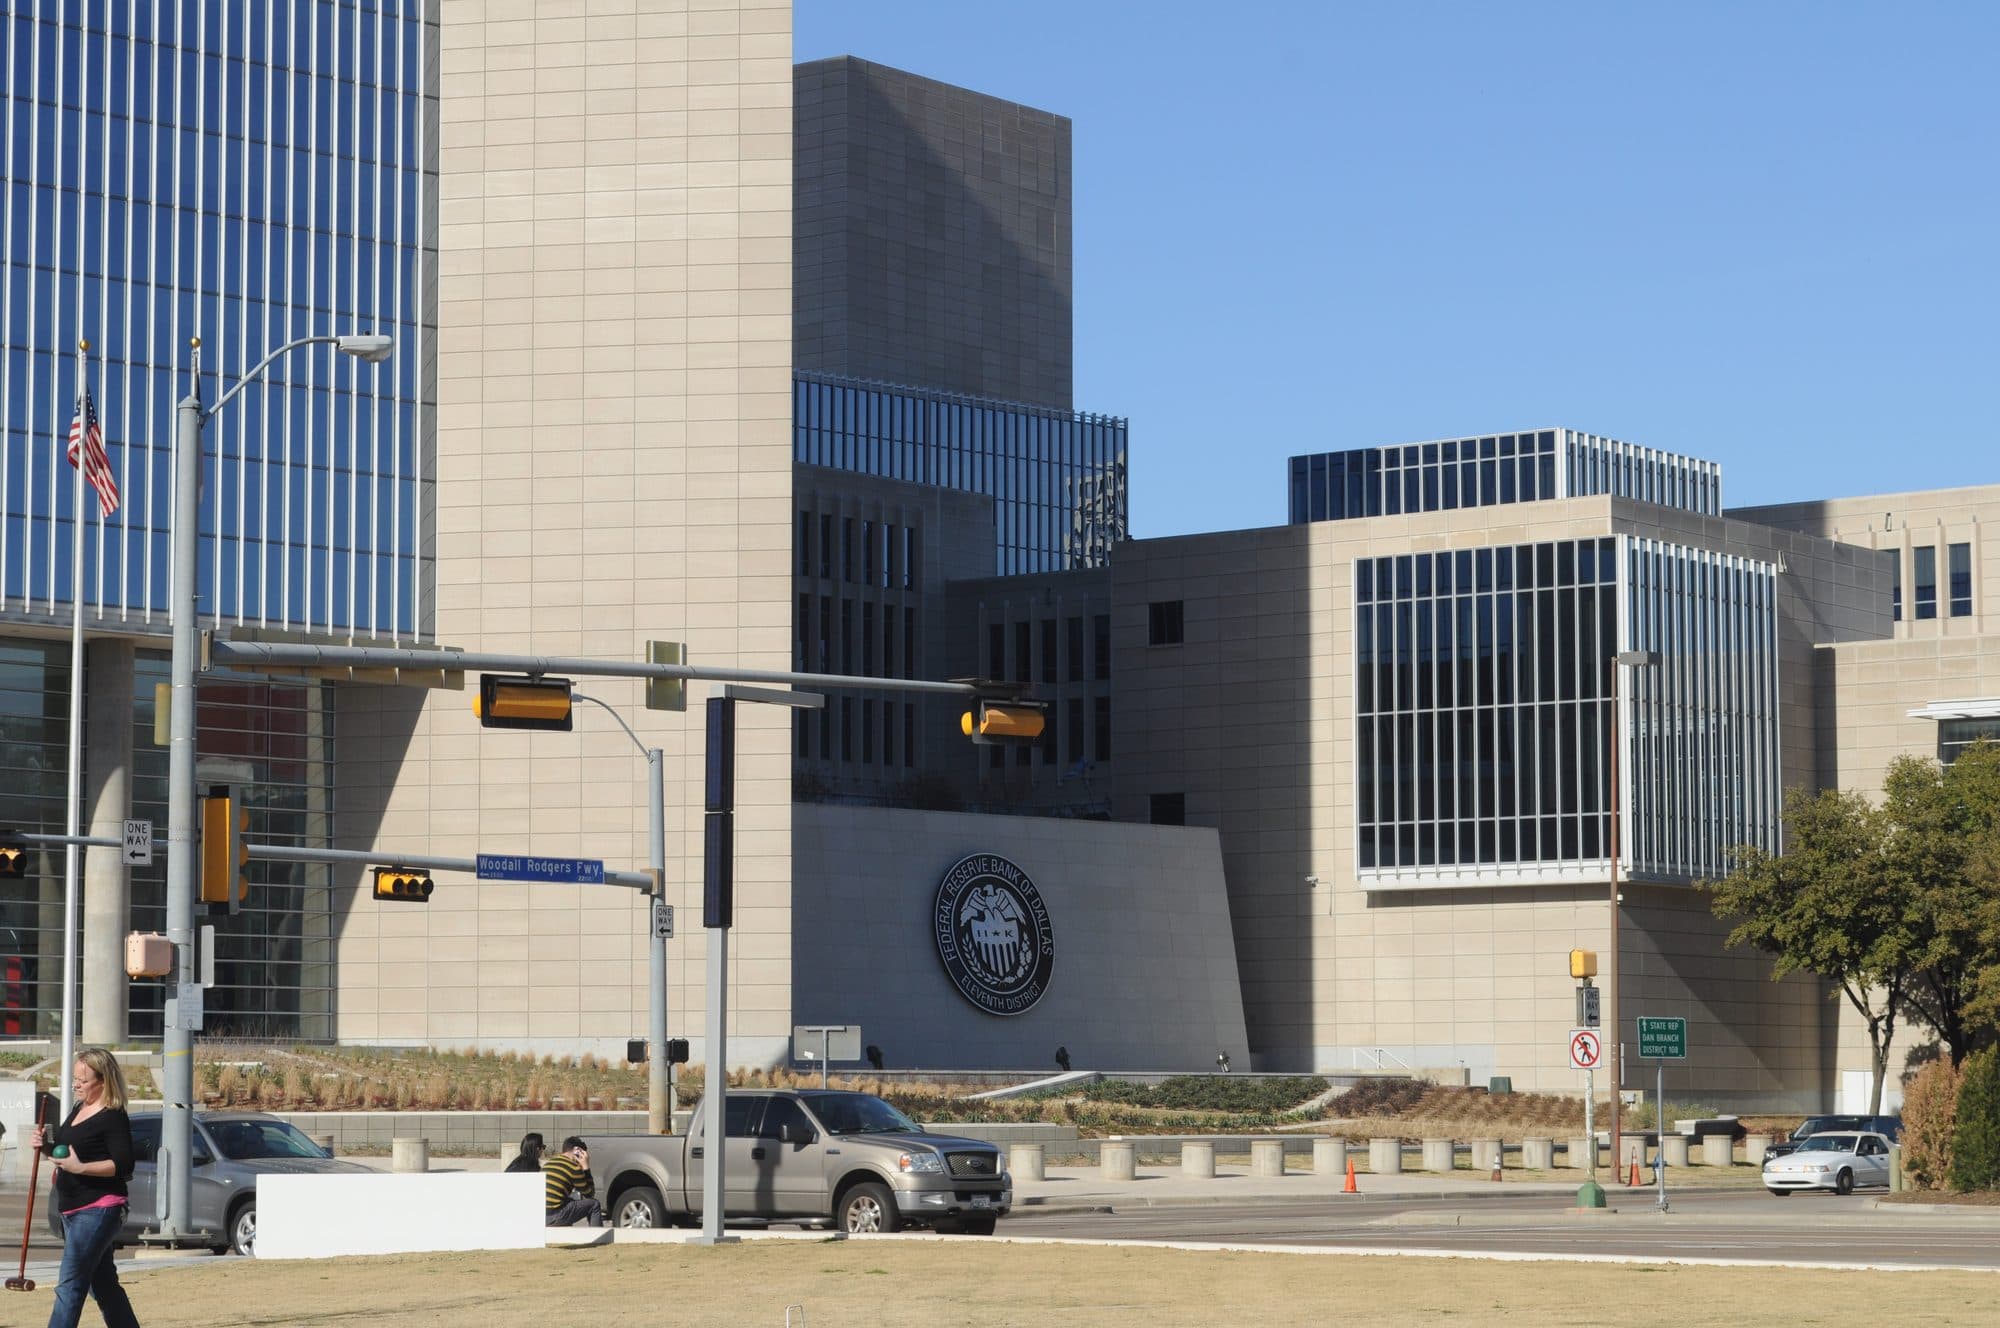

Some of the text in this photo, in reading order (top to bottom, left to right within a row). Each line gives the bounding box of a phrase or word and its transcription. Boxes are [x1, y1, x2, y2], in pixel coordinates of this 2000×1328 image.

[127, 823, 147, 834] ONE
[126, 835, 148, 846] WAY
[479, 857, 521, 871] Woodall
[527, 859, 571, 877] Rodgers
[657, 907, 672, 916] ONE
[939, 858, 1053, 961] FEDERAL RESERVE BANK OF DALLAS
[658, 916, 672, 925] WAY
[1004, 929, 1014, 938] K
[961, 975, 1041, 1010] ELEVENTH DISTRICT
[1586, 990, 1599, 1000] ONE
[1586, 1001, 1598, 1010] WAY
[1650, 1021, 1679, 1031] STATE REP
[1656, 1033, 1679, 1042] BRANCH
[1642, 1045, 1667, 1054] DISTRICT
